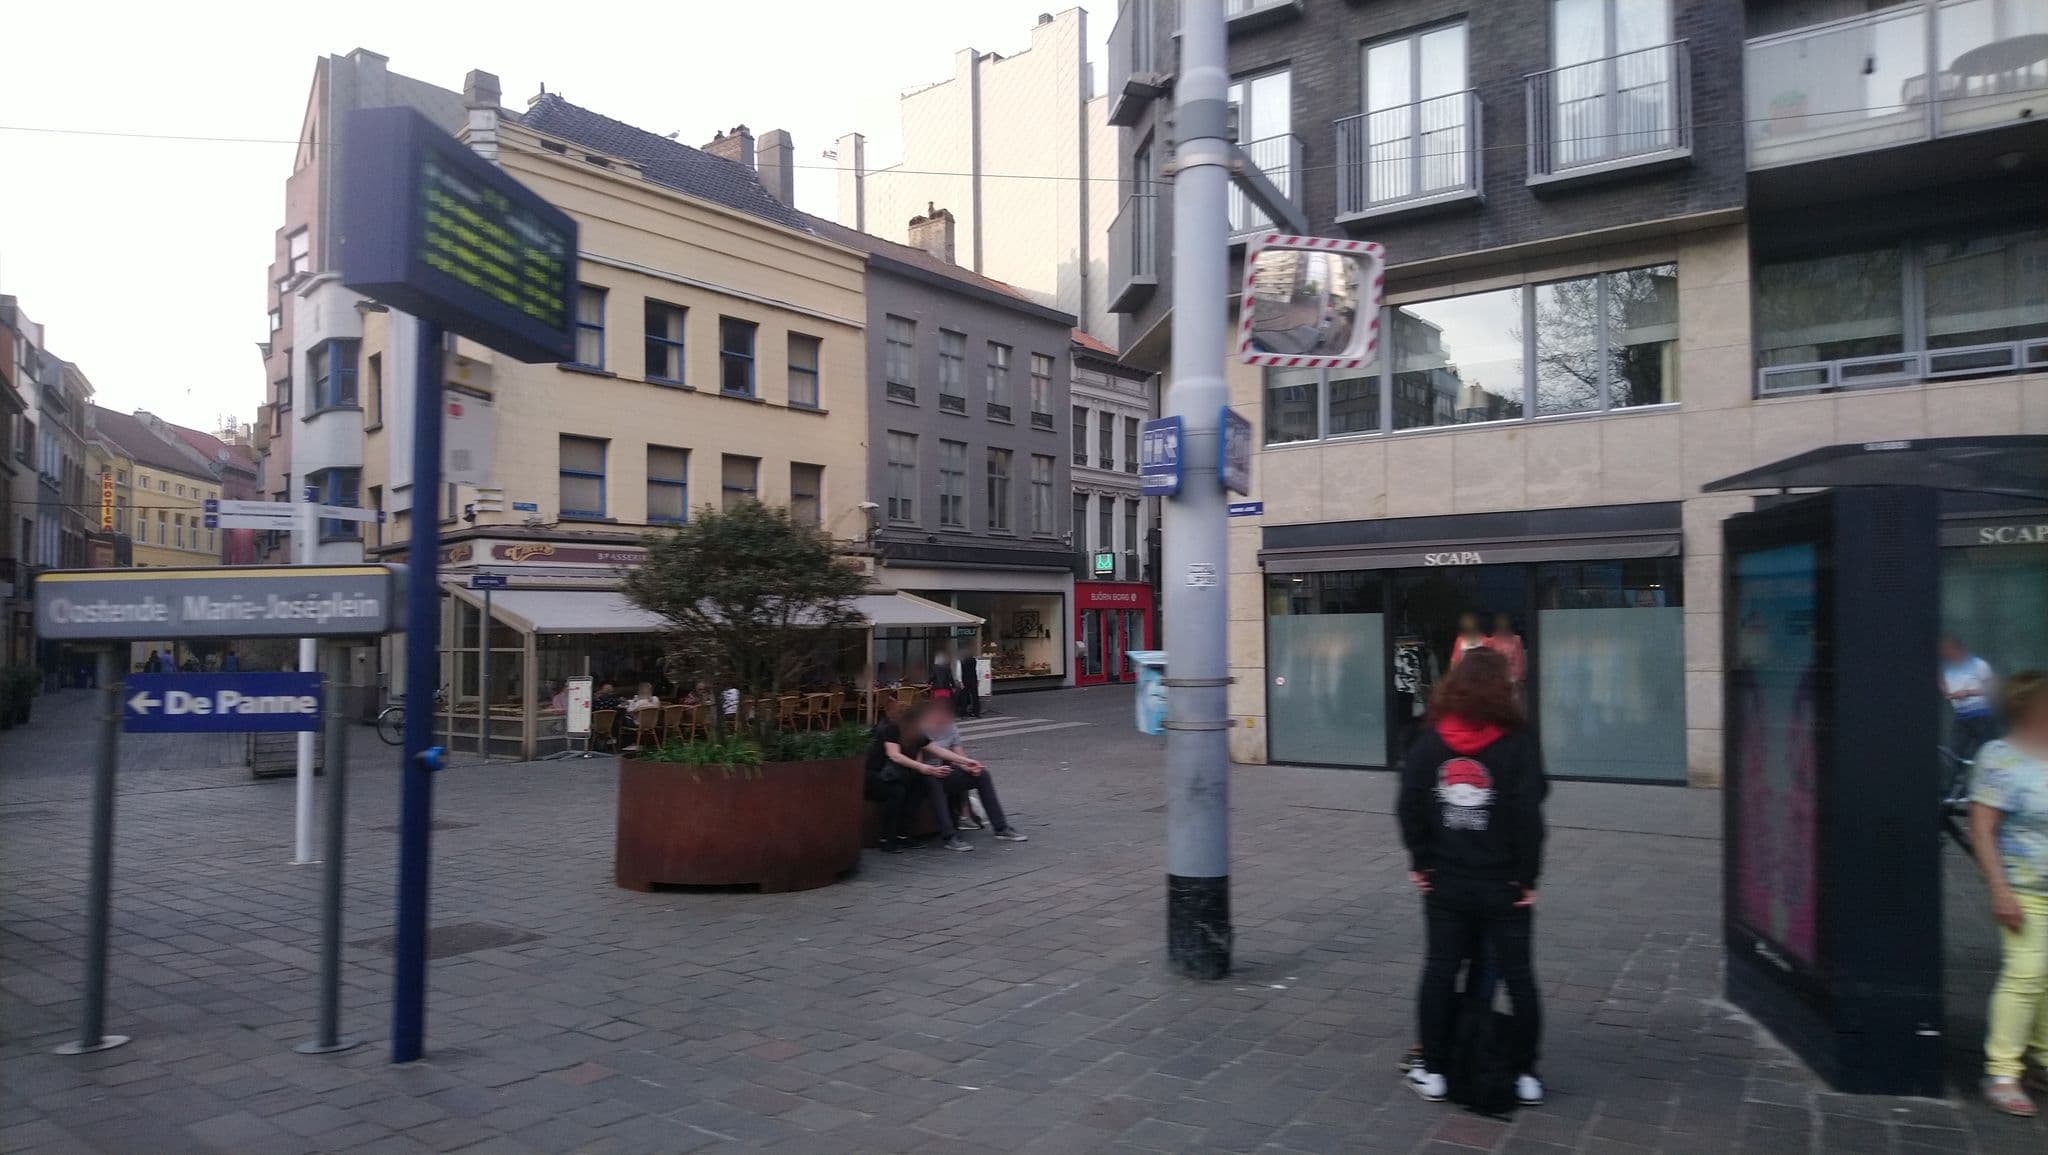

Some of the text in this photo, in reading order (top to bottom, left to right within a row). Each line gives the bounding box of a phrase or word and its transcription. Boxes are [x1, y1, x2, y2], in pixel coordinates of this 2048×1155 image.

[1424, 551, 1482, 566] SCAPA
[50, 598, 168, 623] Oostende
[164, 689, 318, 715] De Panne
